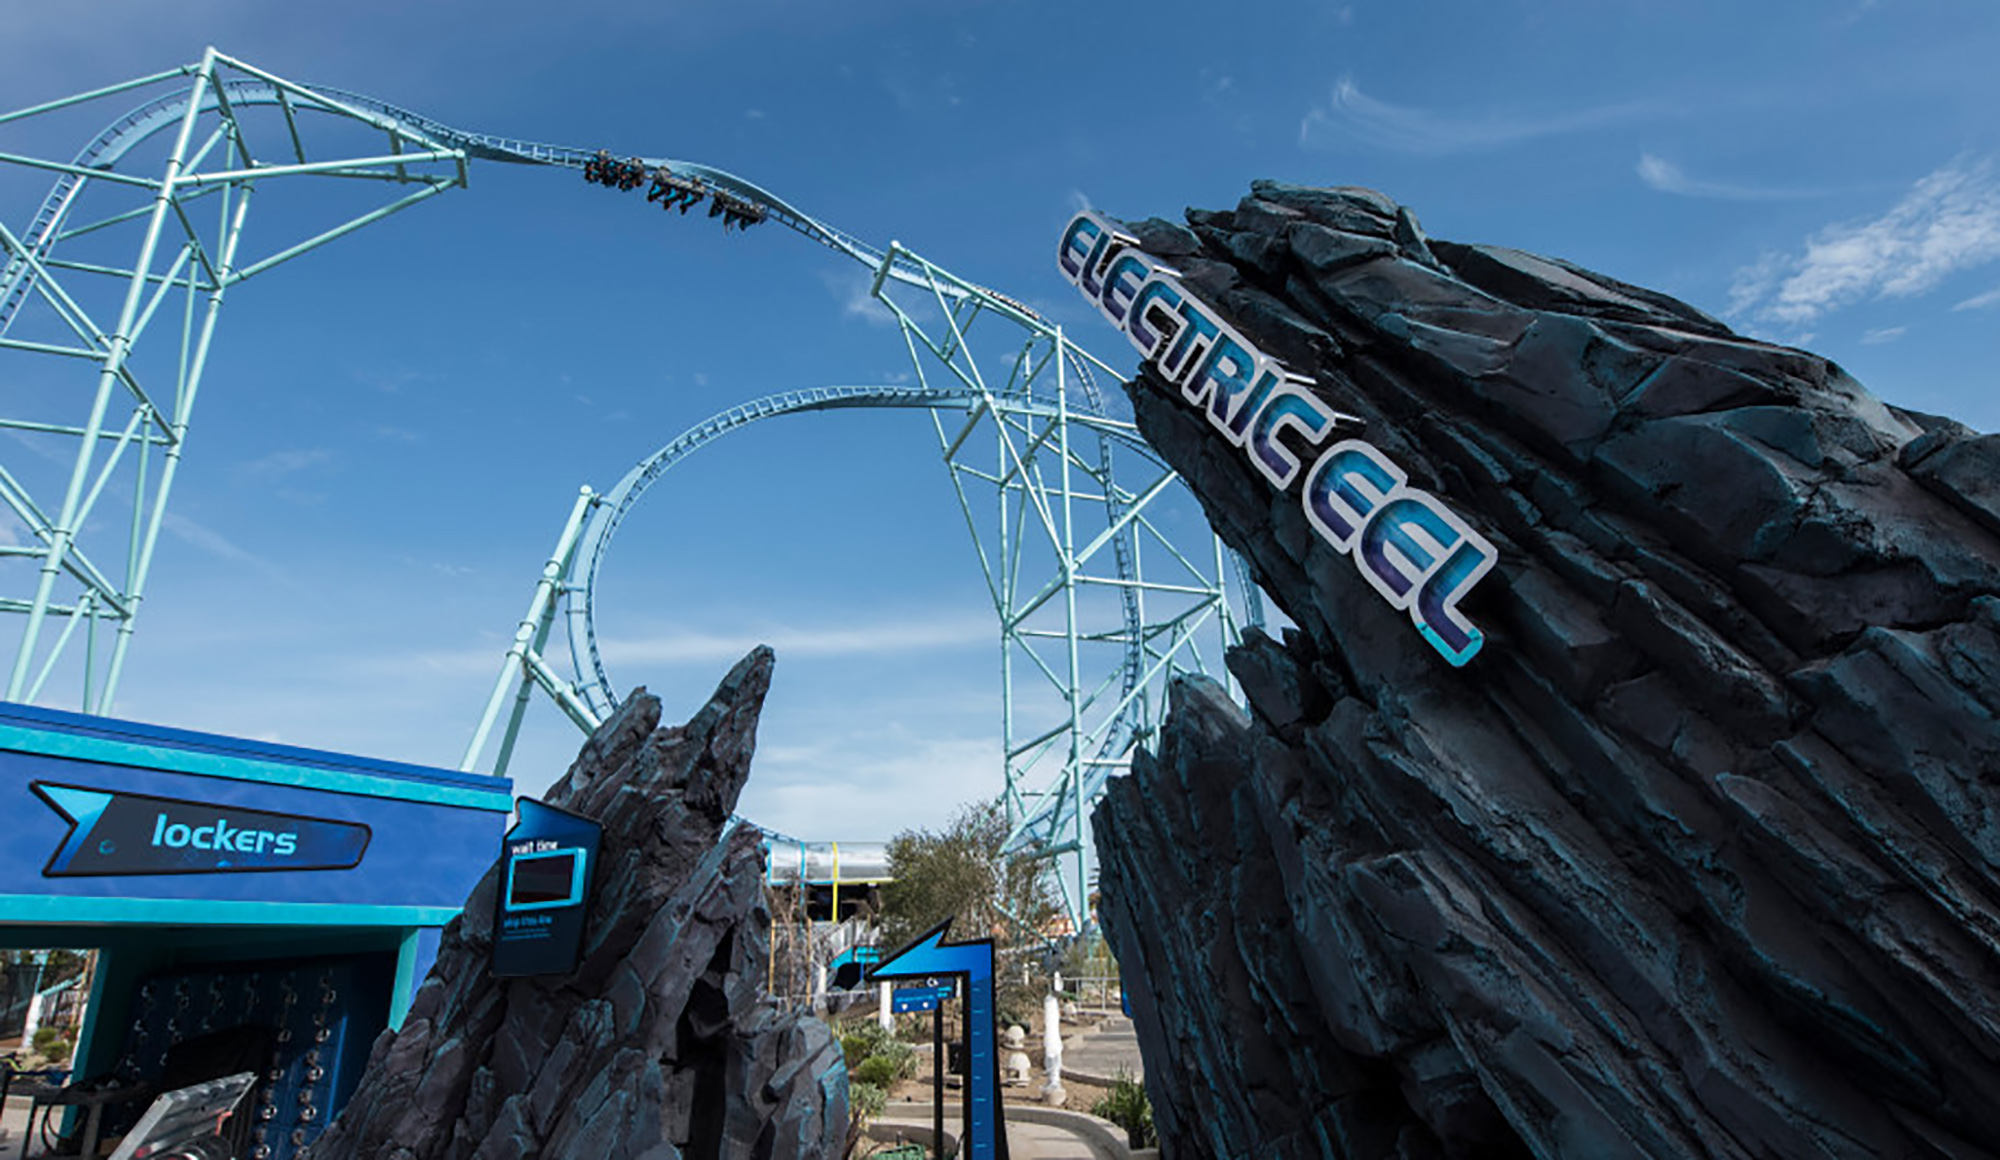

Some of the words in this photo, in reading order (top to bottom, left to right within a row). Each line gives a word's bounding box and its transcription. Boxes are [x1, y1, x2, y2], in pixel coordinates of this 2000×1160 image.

[1058, 211, 1337, 491] ELECTRIC
[1303, 438, 1498, 667] EEL
[151, 813, 297, 855] lockers
